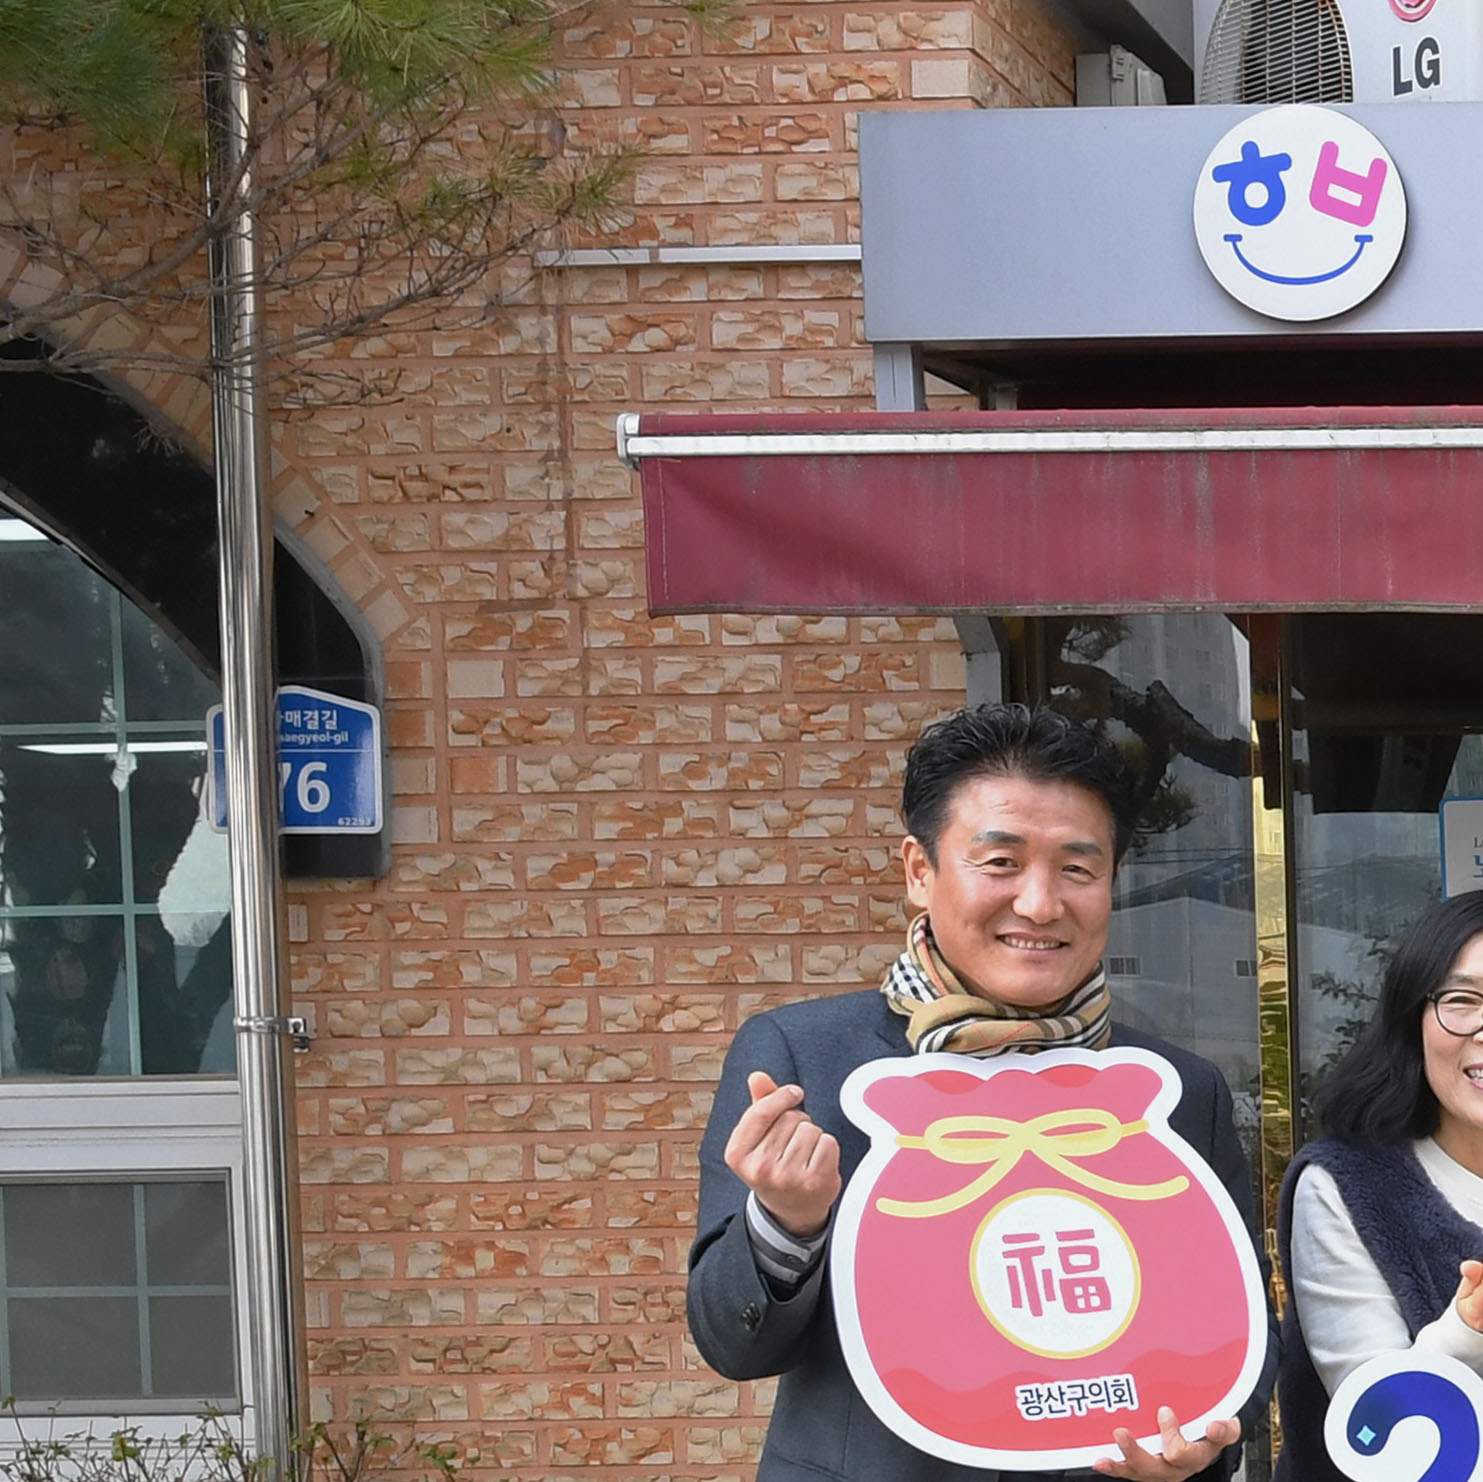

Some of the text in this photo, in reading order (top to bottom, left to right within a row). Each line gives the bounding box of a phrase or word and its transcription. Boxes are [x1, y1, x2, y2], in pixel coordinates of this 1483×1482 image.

[1393, 36, 1440, 96] LG
[279, 709, 338, 730] 매결길
[1001, 1229, 1112, 1317] 福
[1020, 1378, 1135, 1416] 광산구의회
